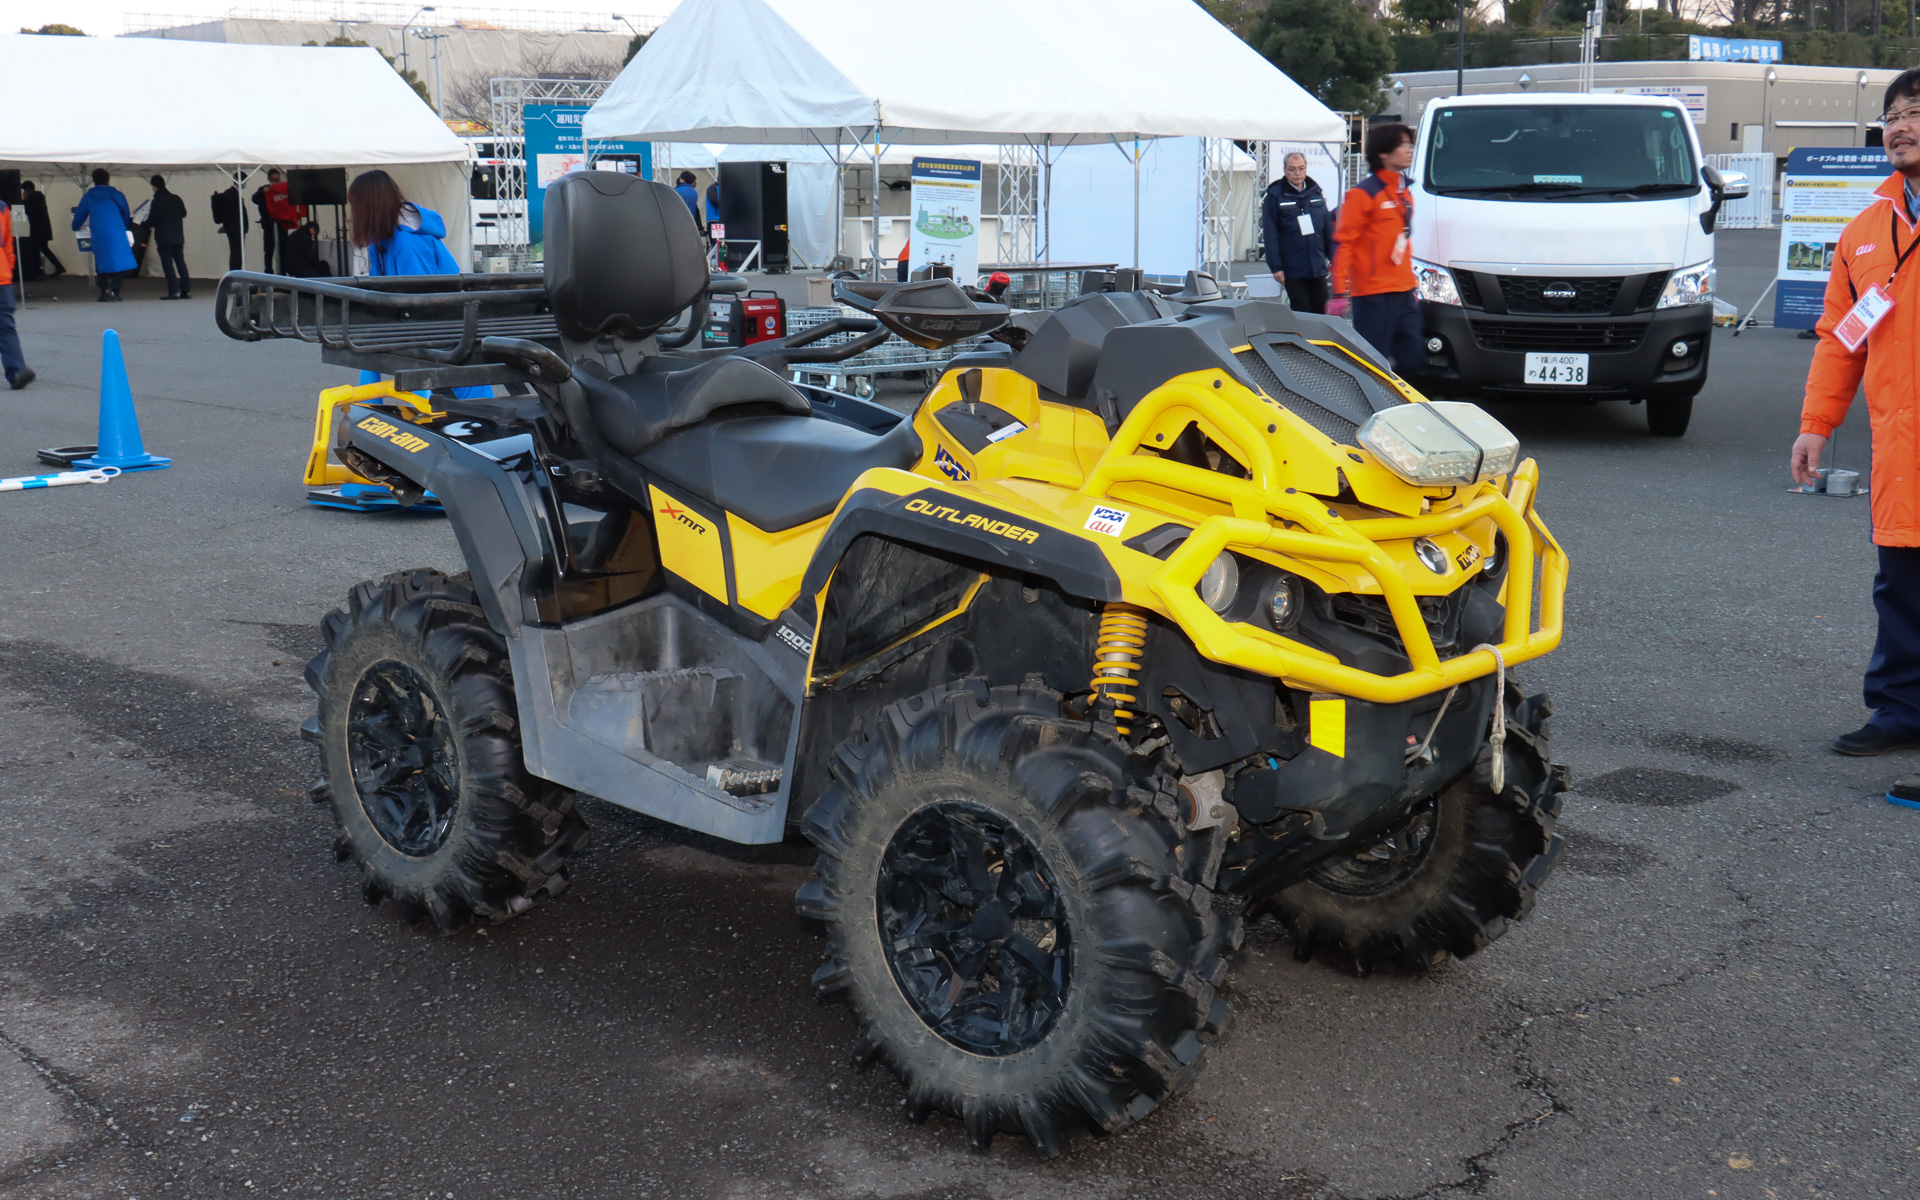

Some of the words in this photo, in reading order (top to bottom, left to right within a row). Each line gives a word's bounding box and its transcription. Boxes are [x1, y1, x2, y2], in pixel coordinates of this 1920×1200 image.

[1702, 42, 1779, 61] 臨港パーク駐車場
[1855, 243, 1877, 257] au
[1543, 290, 1577, 298] ISUZU
[1538, 366, 1584, 382] 44-38
[904, 498, 1040, 545] OUTLANDER
[1093, 507, 1126, 523] KDDI
[1089, 520, 1117, 534] au
